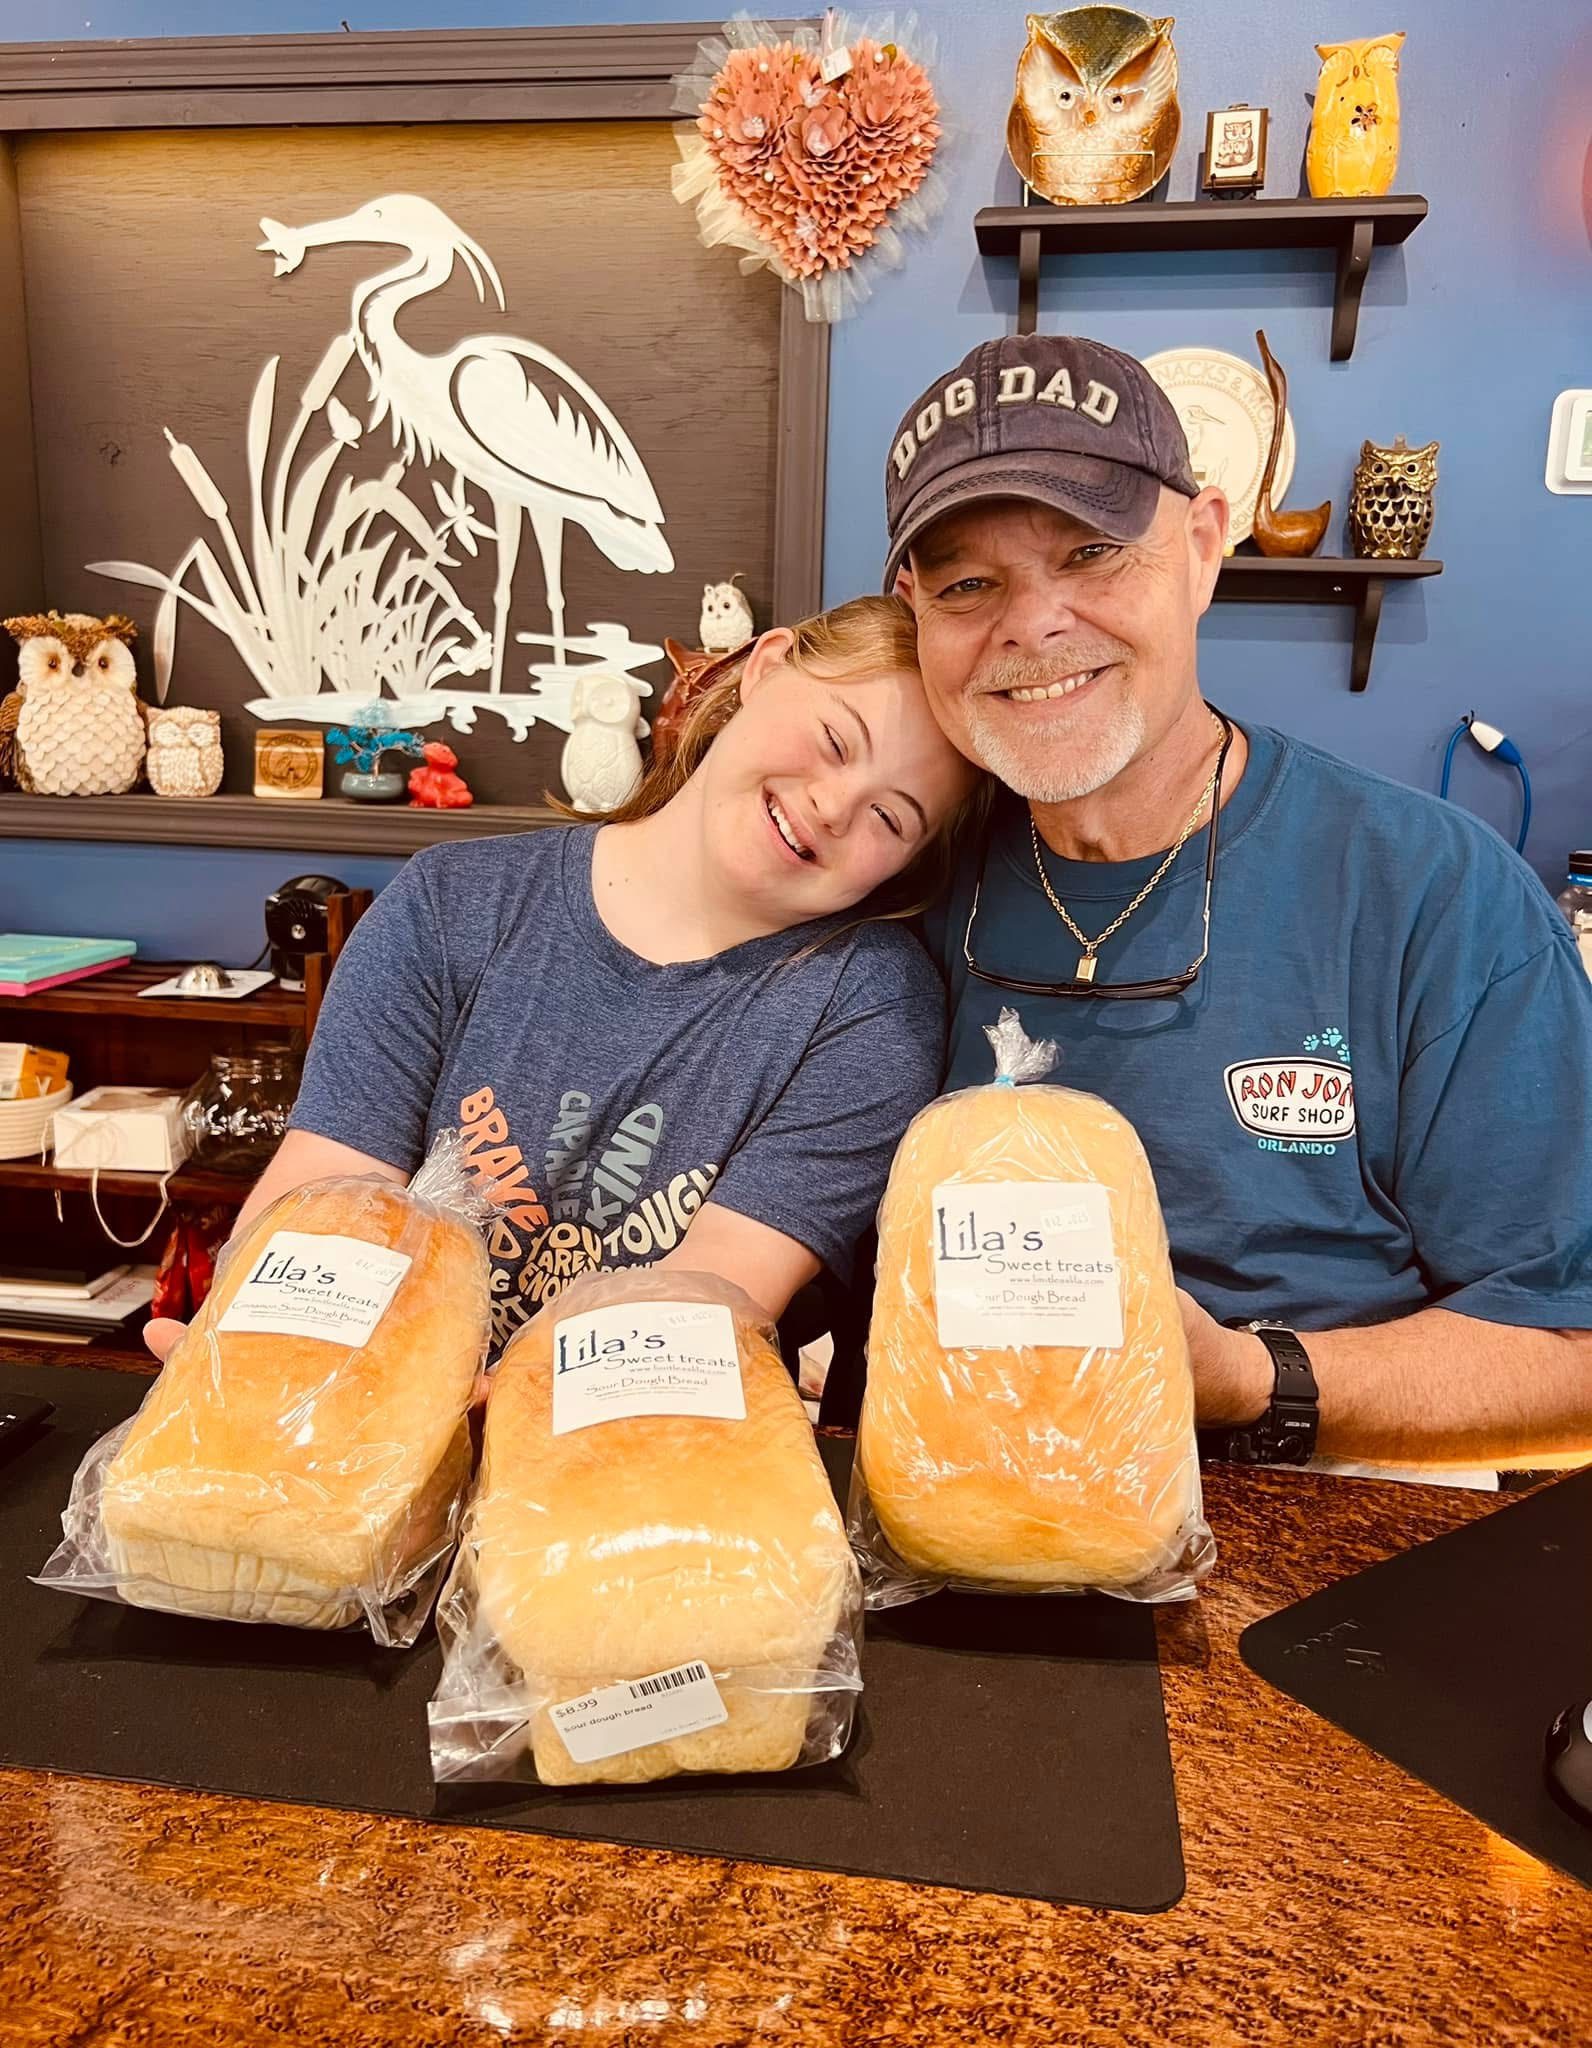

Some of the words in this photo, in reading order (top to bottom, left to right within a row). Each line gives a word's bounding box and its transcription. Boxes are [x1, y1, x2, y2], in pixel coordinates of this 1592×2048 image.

[1155, 359, 1231, 385] NACKS
[1229, 377, 1242, 391] &
[892, 377, 977, 480] DOG
[997, 366, 1119, 428] DAD
[1241, 1070, 1297, 1102] RON
[1251, 1103, 1290, 1122] SURF
[1298, 1107, 1345, 1125] SHOP
[459, 1086, 550, 1232] BRAVE
[1257, 1138, 1337, 1156] ORLANDO
[584, 1103, 664, 1231] KIND
[525, 1222, 602, 1264] YOU
[937, 1206, 1044, 1261] Lila's
[249, 1251, 337, 1285] Lila's
[537, 1247, 587, 1278] ARE
[984, 1253, 1052, 1274] Sweet
[1057, 1259, 1114, 1274] treats
[279, 1282, 331, 1298] Sweet
[335, 1290, 380, 1309] treats
[1002, 1288, 1045, 1305] Dough
[1047, 1289, 1087, 1304] Bread
[338, 1311, 372, 1327] Bread
[557, 1329, 666, 1375] Lila's
[604, 1352, 672, 1370] Sweet
[680, 1352, 737, 1369] treats
[620, 1374, 665, 1388] Dough
[667, 1375, 709, 1386] Bread
[555, 1698, 599, 1718] $8.99
[589, 1711, 622, 1727] dough
[624, 1703, 653, 1717] bread
